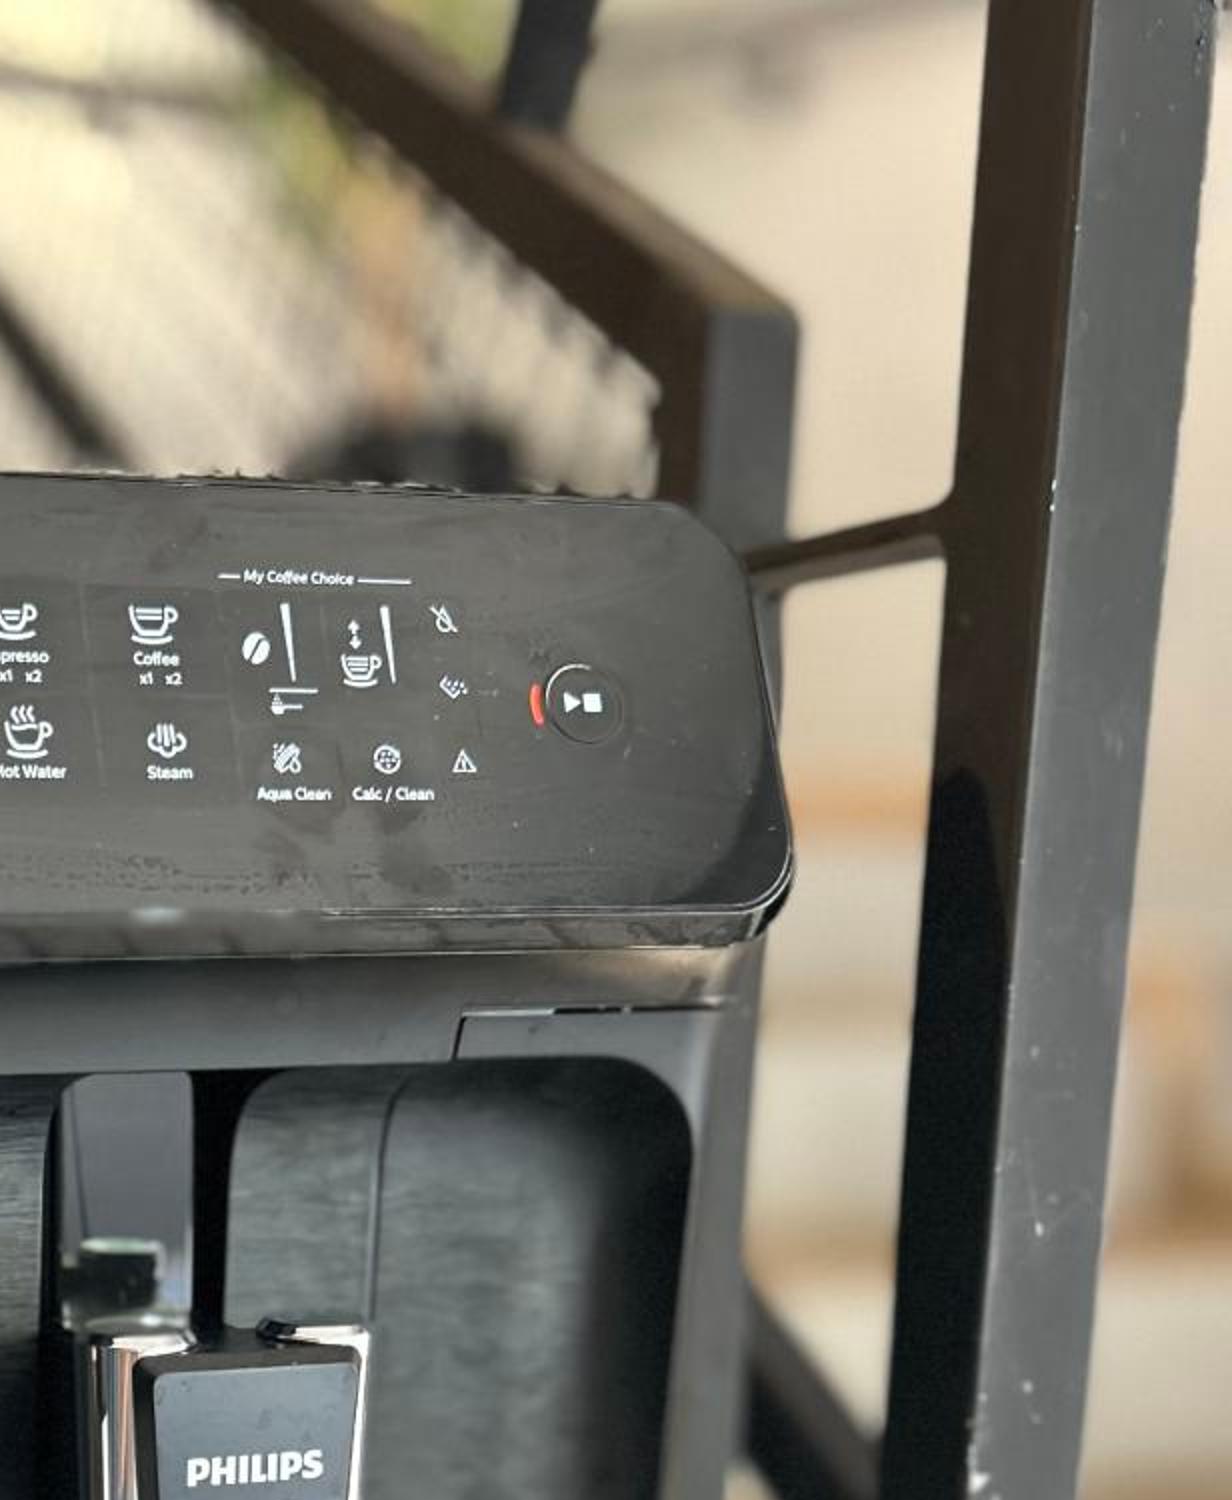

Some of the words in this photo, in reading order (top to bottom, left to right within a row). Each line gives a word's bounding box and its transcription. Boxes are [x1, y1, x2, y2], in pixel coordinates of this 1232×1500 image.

[243, 568, 264, 585] My
[267, 569, 308, 585] Coffee
[310, 571, 354, 586] Choice
[133, 651, 180, 666] Coffee
[25, 669, 42, 683] x2
[139, 672, 153, 685] x1
[165, 673, 183, 686] x2
[21, 764, 67, 779] Water
[146, 765, 193, 779] Steam
[257, 787, 293, 802] Aqua
[294, 786, 332, 800] Clean
[352, 786, 383, 800] Calc
[395, 786, 435, 800] Clean
[186, 1449, 324, 1488] PHILIPS
